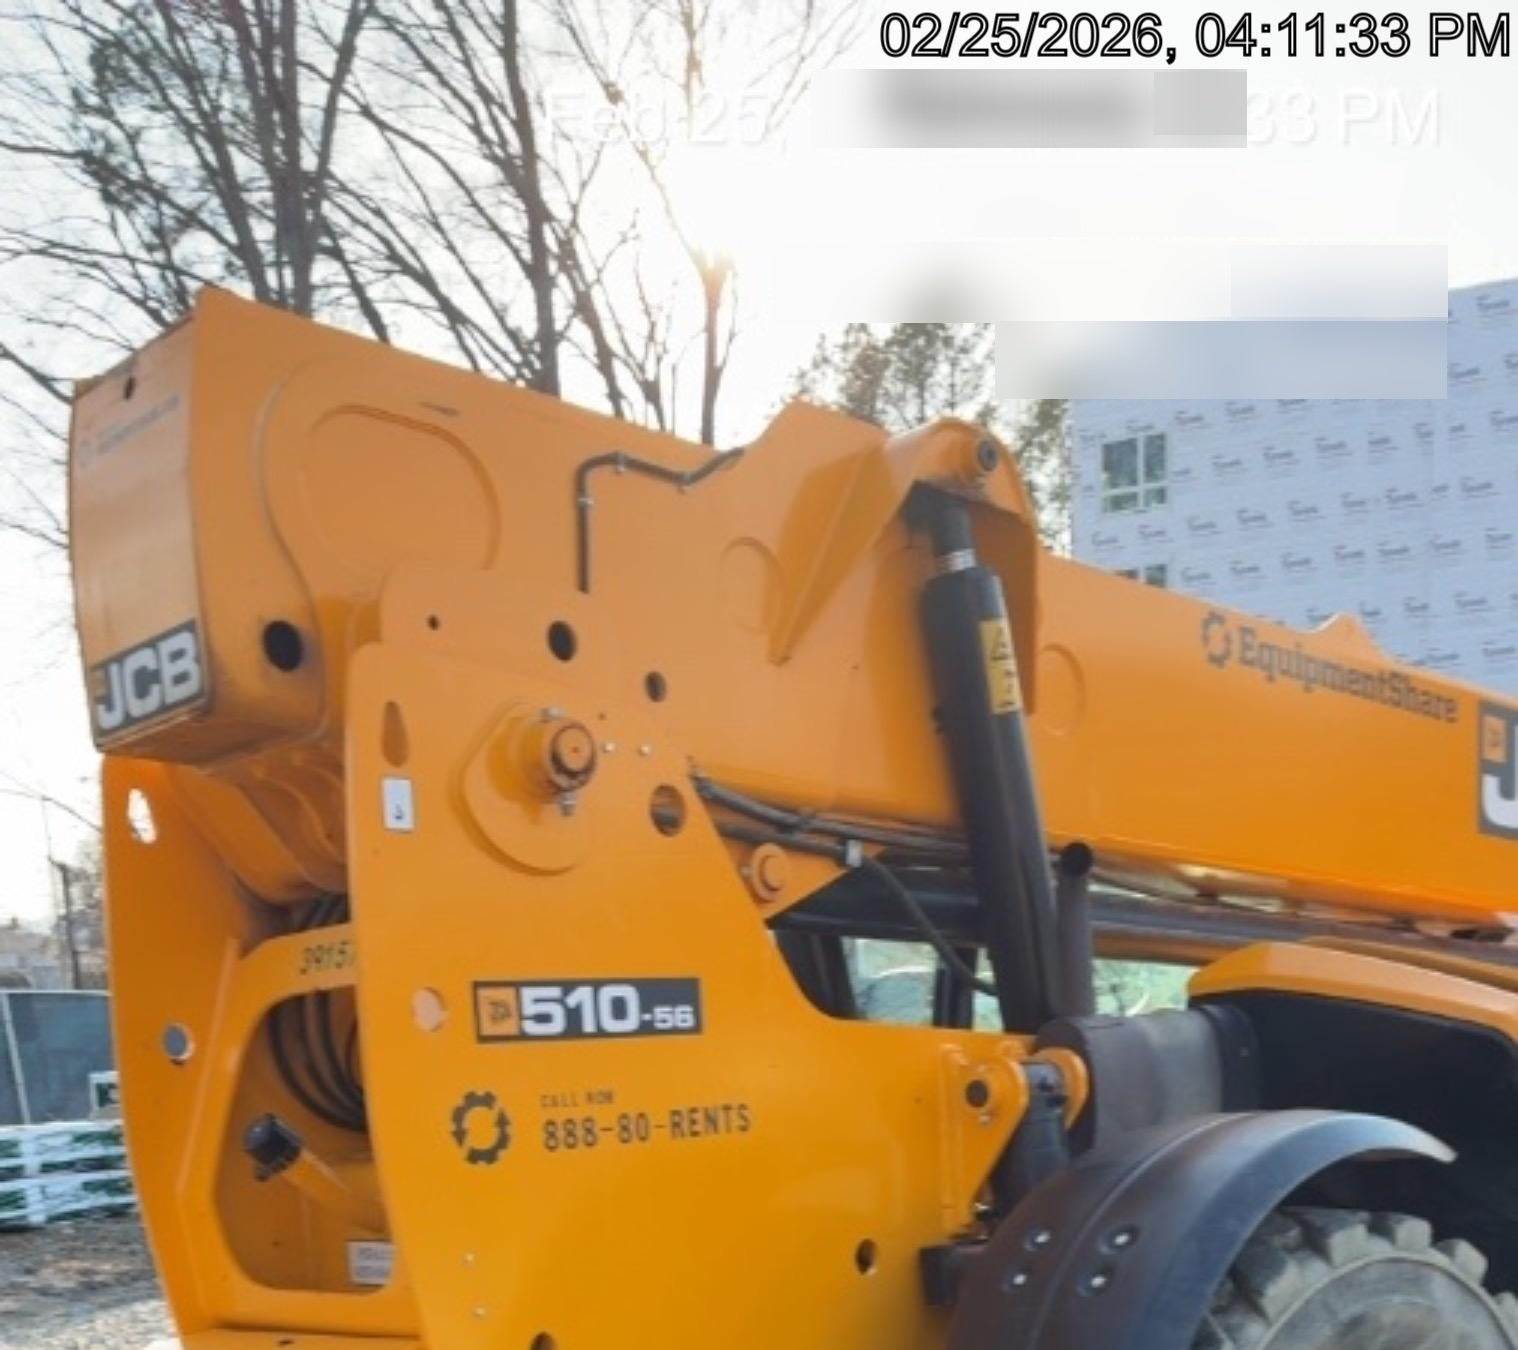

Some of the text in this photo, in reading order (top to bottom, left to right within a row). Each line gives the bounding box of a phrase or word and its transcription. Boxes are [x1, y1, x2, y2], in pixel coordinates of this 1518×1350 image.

[95, 630, 201, 729] JCB
[1238, 625, 1458, 723] EquipmentShare
[519, 984, 696, 1036] 510-56
[541, 1093, 579, 1108] CALL
[543, 1103, 751, 1151] 888-80-RENTS
